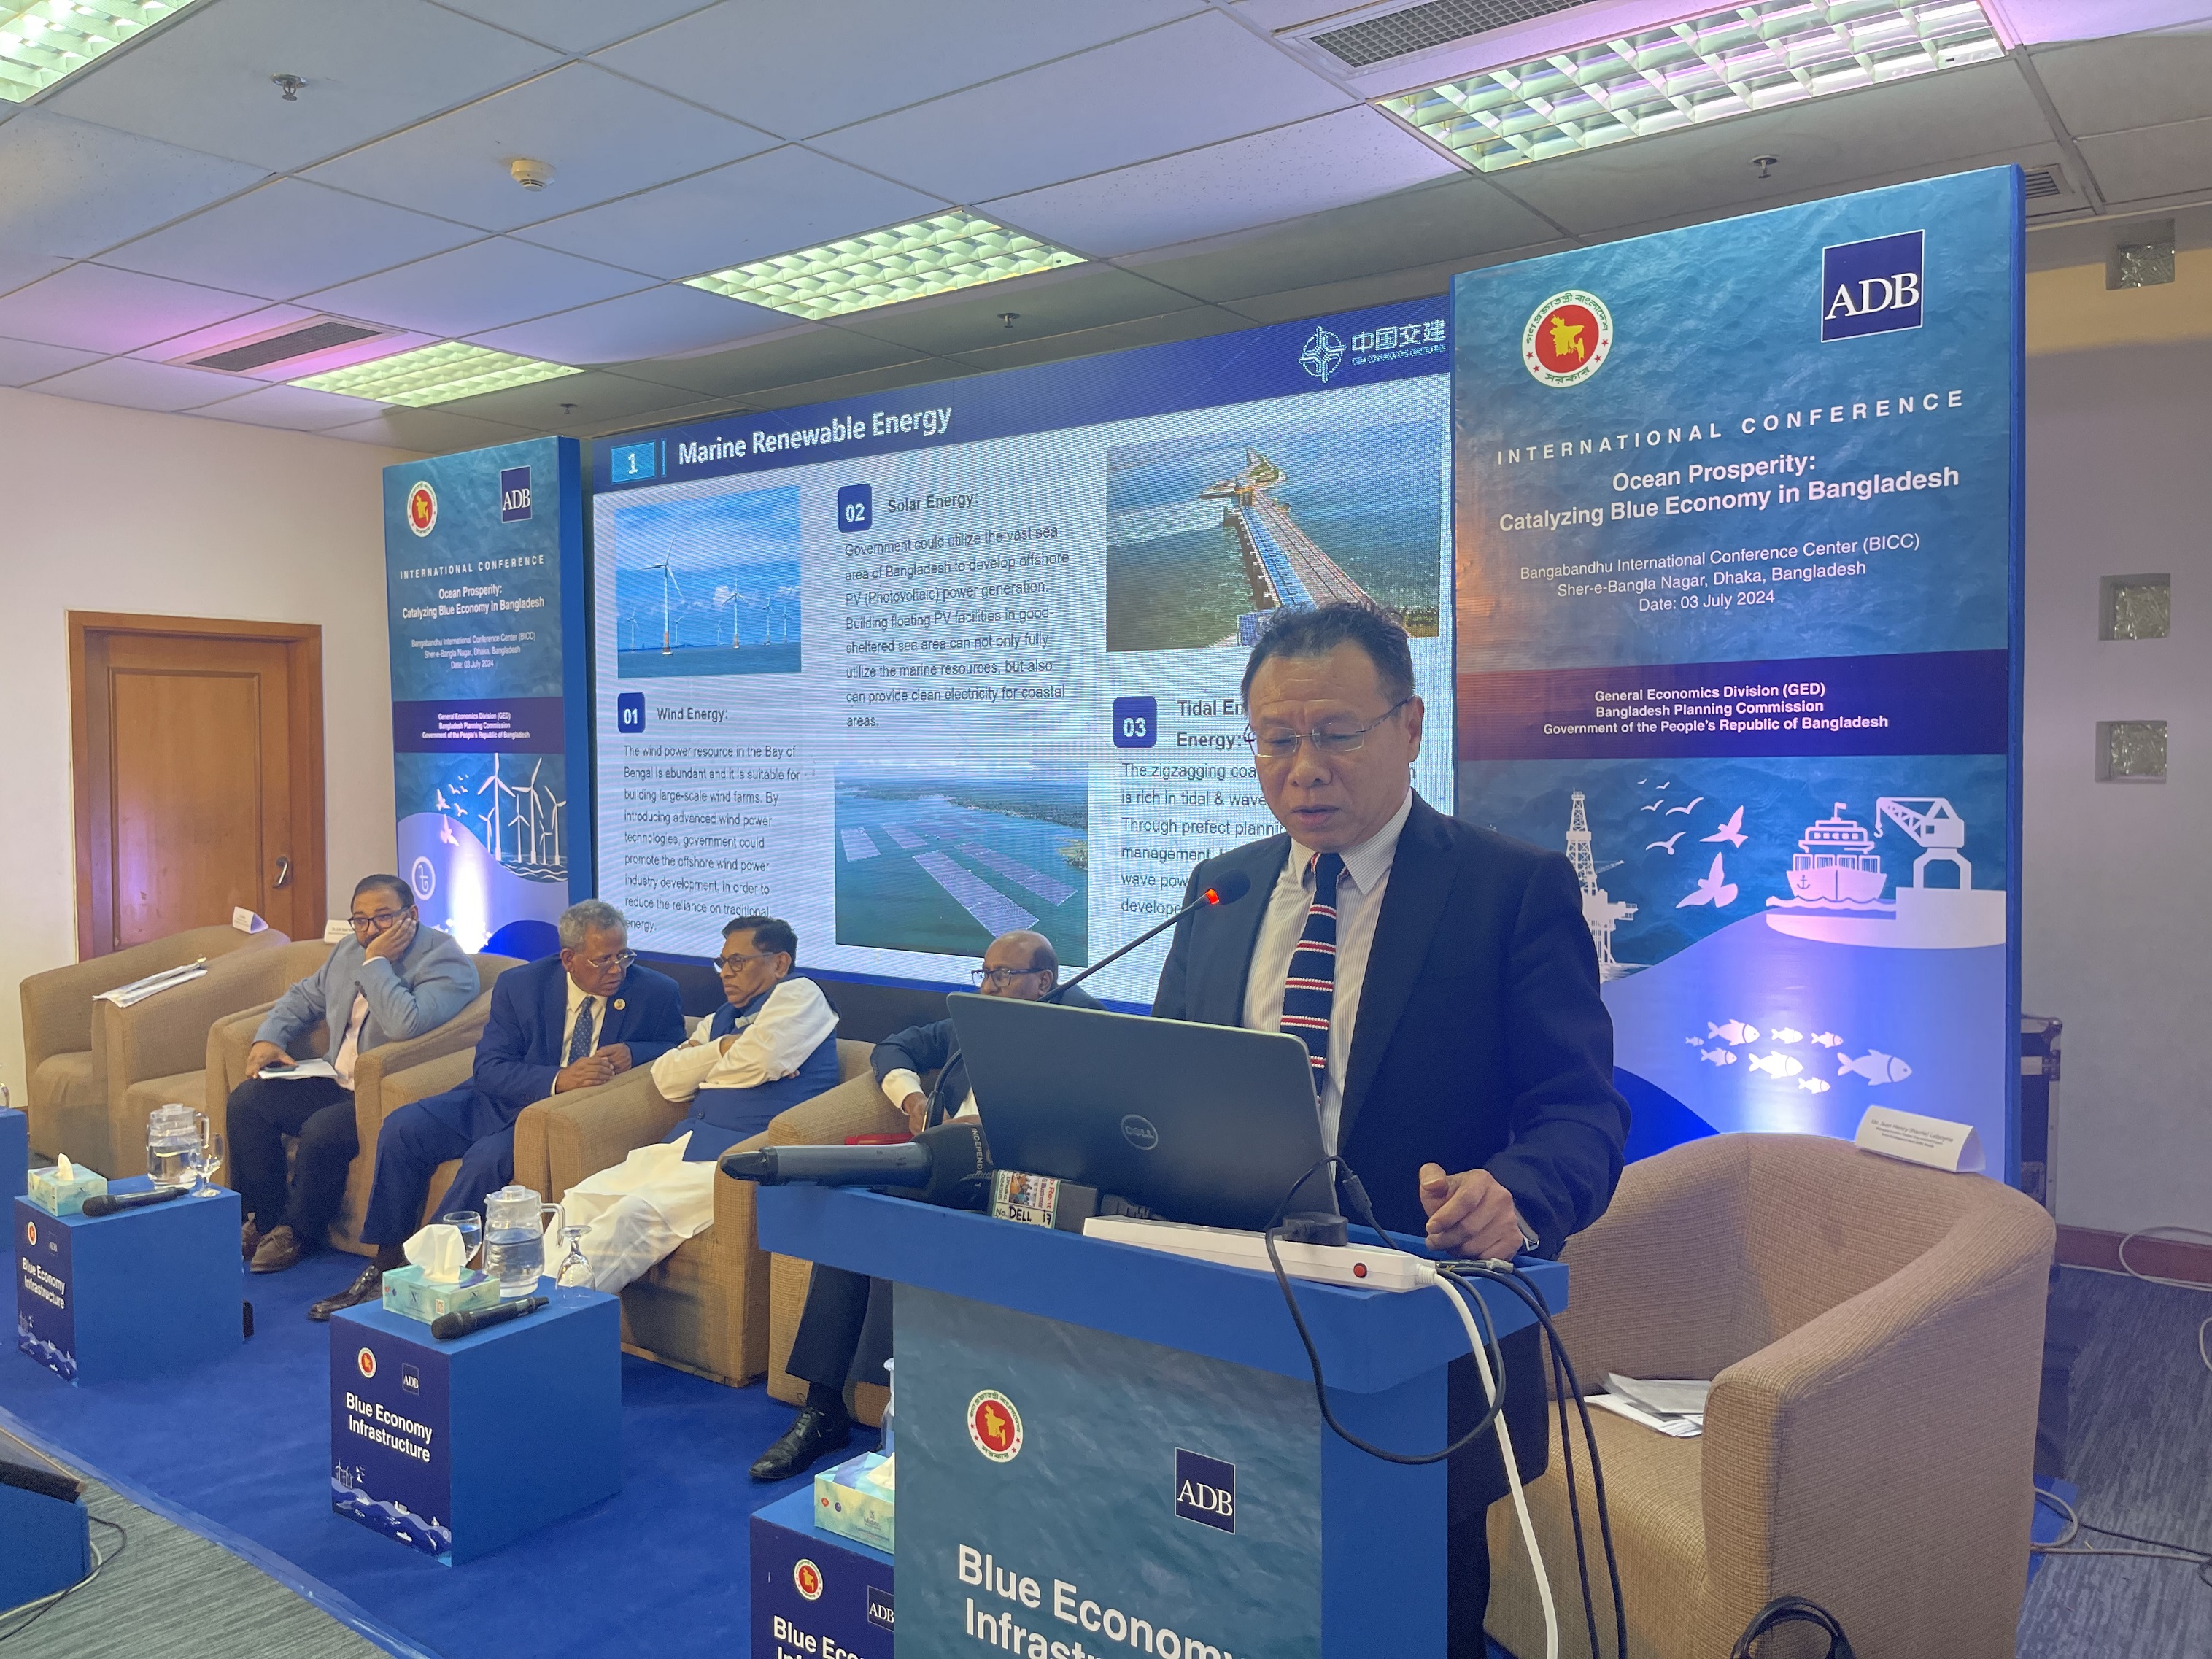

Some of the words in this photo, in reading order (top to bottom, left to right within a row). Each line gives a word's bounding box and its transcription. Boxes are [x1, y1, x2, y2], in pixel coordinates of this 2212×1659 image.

[1825, 272, 1919, 320] ADB
[1352, 319, 1446, 353] 中国交建
[1545, 366, 1590, 384] সরকার
[678, 437, 746, 465] Marine
[753, 416, 865, 453] Renewable
[873, 407, 952, 436] Energy
[1498, 423, 1722, 465] INTERNATIONAL
[1741, 390, 1963, 435] CONFERENCE
[628, 453, 638, 473] 1
[1612, 467, 1681, 492] Ocean
[1688, 454, 1816, 484] Prosperity:
[503, 489, 530, 511] ADB
[888, 499, 921, 513] Solar
[927, 492, 978, 508] Energy:
[1499, 507, 1604, 533] Catalyzing
[1610, 499, 1659, 522] Blue
[1665, 486, 1771, 516] Economy
[1777, 484, 1801, 503] in
[1809, 467, 1960, 500] Bangladesh
[846, 503, 865, 522] 02
[846, 540, 911, 556] Government
[915, 535, 944, 550] could
[948, 533, 981, 547] utilize
[985, 531, 1002, 544] the
[1007, 527, 1032, 541] vast
[1035, 527, 1058, 538] sea
[400, 563, 473, 579] INTERNATIONAL
[478, 555, 544, 571] CONFERENCE
[1520, 559, 1613, 582] Bangabandhu
[1617, 553, 1706, 573] International
[1710, 546, 1798, 565] Conference
[1803, 540, 1859, 557] Center
[1863, 534, 1920, 554] (BICC)
[1558, 577, 1657, 598] Sher-e-Bangla
[1660, 574, 1709, 592] Nagar,
[1713, 570, 1767, 587] Dhaka,
[1771, 562, 1866, 584] Bangladesh
[439, 587, 461, 599] Ocean
[463, 584, 503, 598] Prosperity:
[1639, 595, 1677, 612] Date:
[1680, 595, 1699, 609] 03
[1703, 592, 1733, 611] July
[1736, 590, 1775, 606] 2024
[403, 607, 437, 620] Catalyzing
[438, 605, 455, 616] Blue
[456, 602, 490, 614] Economy
[491, 600, 498, 611] in
[500, 597, 544, 612] Bangladesh
[846, 639, 895, 654] sheltered
[898, 643, 917, 651] sea
[921, 641, 946, 650] area
[950, 639, 970, 649] can
[974, 635, 993, 648] not
[996, 634, 1021, 649] only
[1025, 632, 1048, 648] fully
[846, 667, 876, 678] utilize
[880, 665, 896, 676] the
[900, 664, 937, 676] marine
[940, 662, 1001, 675] resources,
[1005, 660, 1024, 673] but
[1028, 660, 1053, 672] also
[846, 692, 865, 703] can
[868, 689, 908, 705] provide
[911, 688, 940, 701] clean
[945, 687, 997, 703] electricity
[1002, 687, 1018, 698] for
[1021, 684, 1064, 698] coastal
[1594, 689, 1643, 702] General
[1647, 687, 1720, 700] Economics
[1723, 684, 1779, 697] Division
[1782, 683, 1825, 697] (GED)
[498, 712, 511, 720] (GED)
[624, 708, 638, 724] 01
[657, 708, 684, 720] Wind
[687, 708, 728, 722] Energy:
[1177, 700, 1217, 716] Tidal
[1596, 704, 1671, 719] Bangladesh
[1674, 703, 1733, 717] Planning
[1736, 700, 1824, 714] Commission
[1123, 717, 1146, 737] 03
[1544, 722, 1618, 735] Government
[1621, 721, 1634, 732] of
[1636, 721, 1657, 732] the
[1719, 718, 1779, 733] Republic
[1783, 717, 1798, 730] of
[1801, 715, 1889, 732] Bangladesh
[1177, 732, 1241, 750] Energy:
[624, 746, 639, 757] The
[643, 745, 662, 757] wind
[665, 748, 691, 759] power
[694, 748, 732, 757] resource
[737, 746, 744, 757] in
[748, 746, 762, 757] the
[765, 746, 783, 759] Bay
[786, 746, 796, 757] of
[1122, 763, 1147, 777] The
[1152, 763, 1225, 780] zigzagging
[1122, 790, 1132, 803] is
[1137, 790, 1160, 803] rich
[1166, 790, 1176, 803] in
[1182, 791, 1209, 805] tidal
[1214, 792, 1224, 805] &
[1230, 795, 1267, 805] wave
[1121, 817, 1177, 835] Through
[1182, 820, 1230, 835] prefect
[1121, 848, 1209, 862] management
[1121, 875, 1156, 886] wave
[1161, 877, 1188, 889] pow
[1893, 1124, 1909, 1132] Henry
[1009, 1205, 1032, 1222] DELL
[23, 1257, 36, 1275] Blue
[37, 1265, 65, 1295] Economy
[24, 1275, 64, 1309] Infrastructure
[403, 1375, 419, 1388] ADB
[347, 1392, 373, 1417] Blue
[376, 1404, 432, 1444] Economy
[349, 1415, 430, 1462] Infrastructure
[1177, 1480, 1233, 1517] ADB
[959, 1544, 1041, 1608] Blue
[1053, 1578, 1235, 1659] Econom
[869, 1602, 894, 1623] ADB
[773, 1615, 816, 1653] Blue
